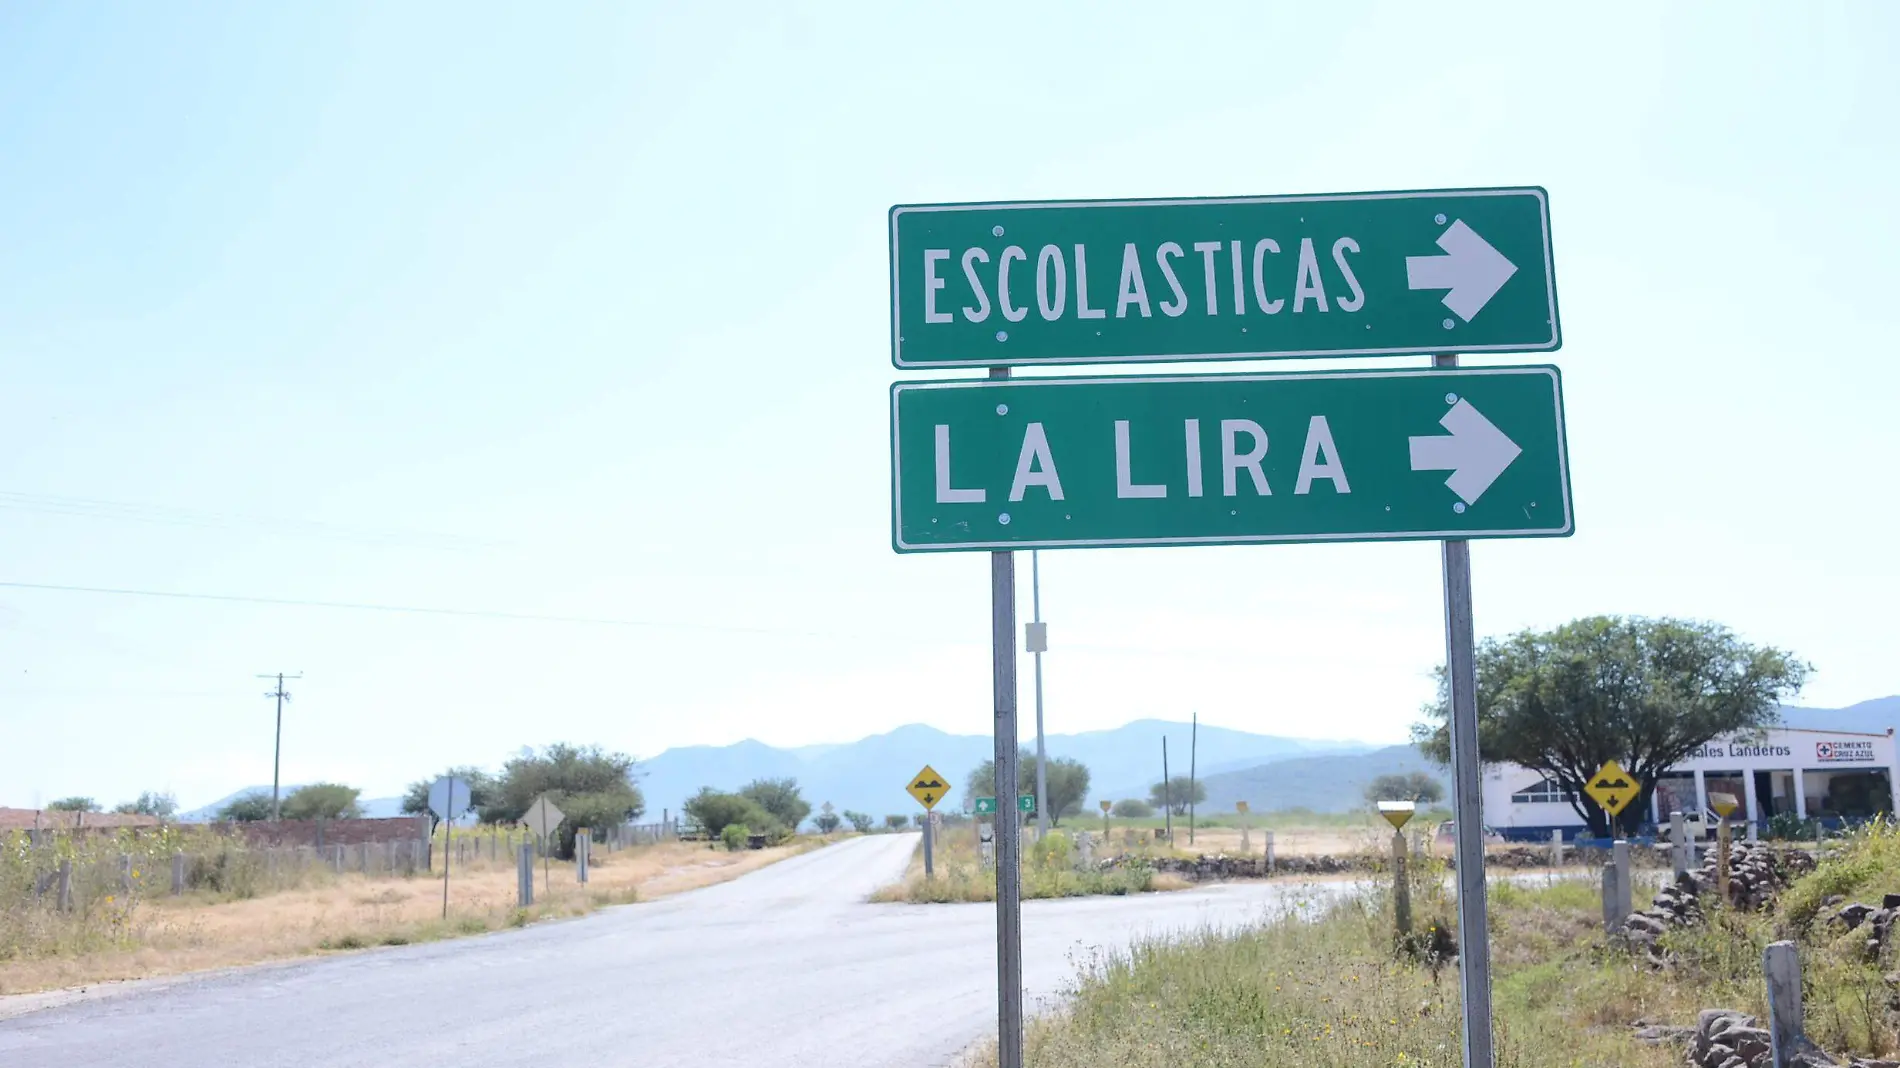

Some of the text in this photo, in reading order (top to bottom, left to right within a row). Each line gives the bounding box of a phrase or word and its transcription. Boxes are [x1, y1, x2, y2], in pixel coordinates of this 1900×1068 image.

[924, 237, 1366, 324] ESCOLASTICAS
[935, 415, 1352, 503] LA LIRA
[1729, 743, 1791, 758] Landeros
[1832, 741, 1873, 749] CEMENTO
[1024, 798, 1031, 808] 3
